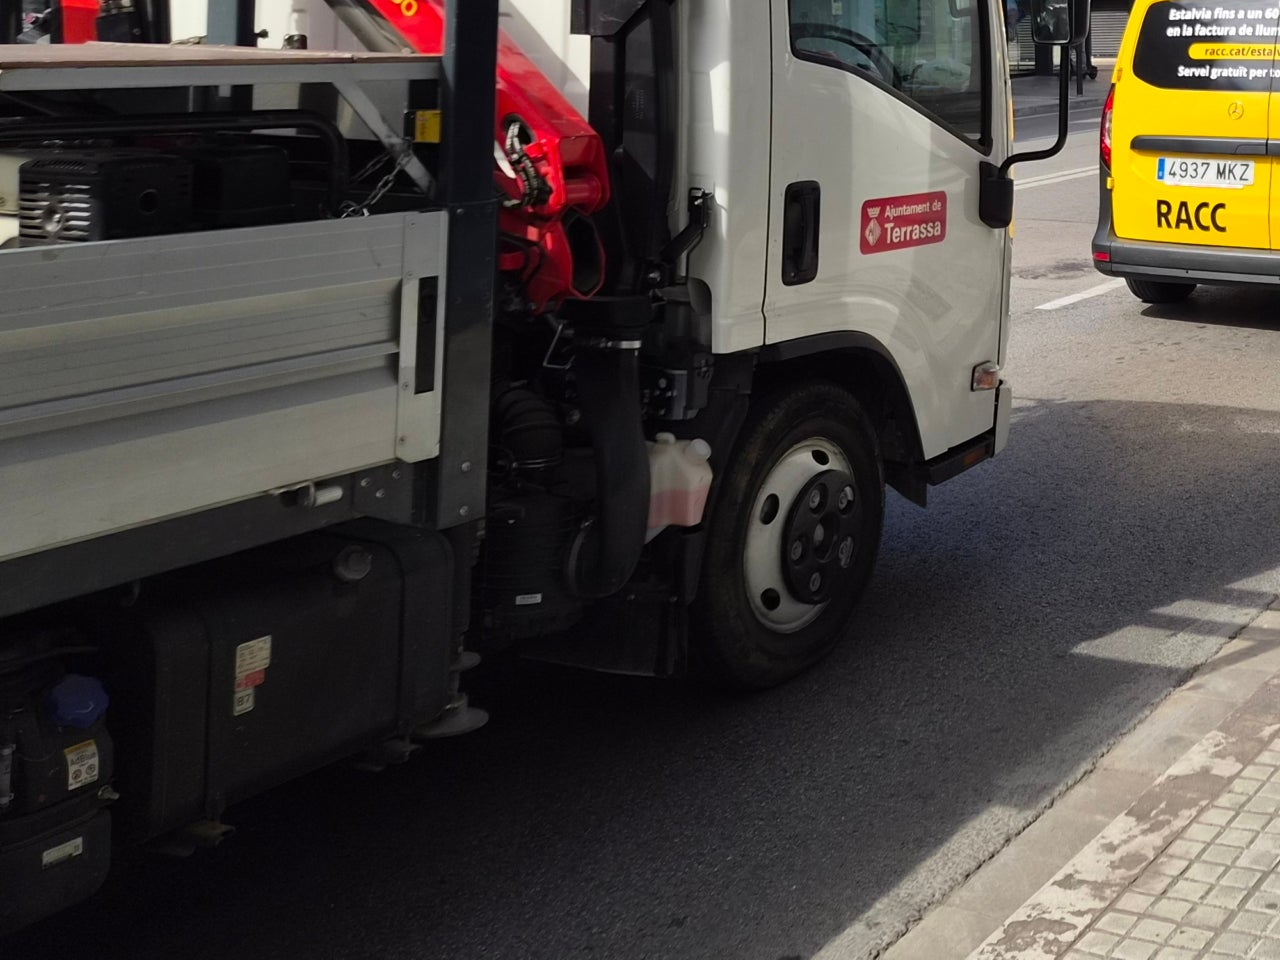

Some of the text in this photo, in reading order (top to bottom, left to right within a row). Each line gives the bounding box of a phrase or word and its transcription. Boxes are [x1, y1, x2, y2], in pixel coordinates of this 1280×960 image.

[1169, 7, 1212, 21] Estalvia
[1214, 7, 1236, 20] fins
[1237, 10, 1245, 20] a
[1247, 10, 1262, 19] un
[1166, 27, 1181, 37] en
[1182, 24, 1193, 37] la
[1195, 24, 1236, 37] factura
[1238, 24, 1253, 37] de
[1177, 65, 1210, 78] Servei
[1210, 66, 1248, 79] gratuït
[1249, 69, 1267, 80] per
[1168, 162, 1250, 182] 4937 MKZ
[884, 200, 942, 220] Ajuntament de
[1156, 199, 1227, 233] RACC
[884, 221, 942, 244] Terrassa
